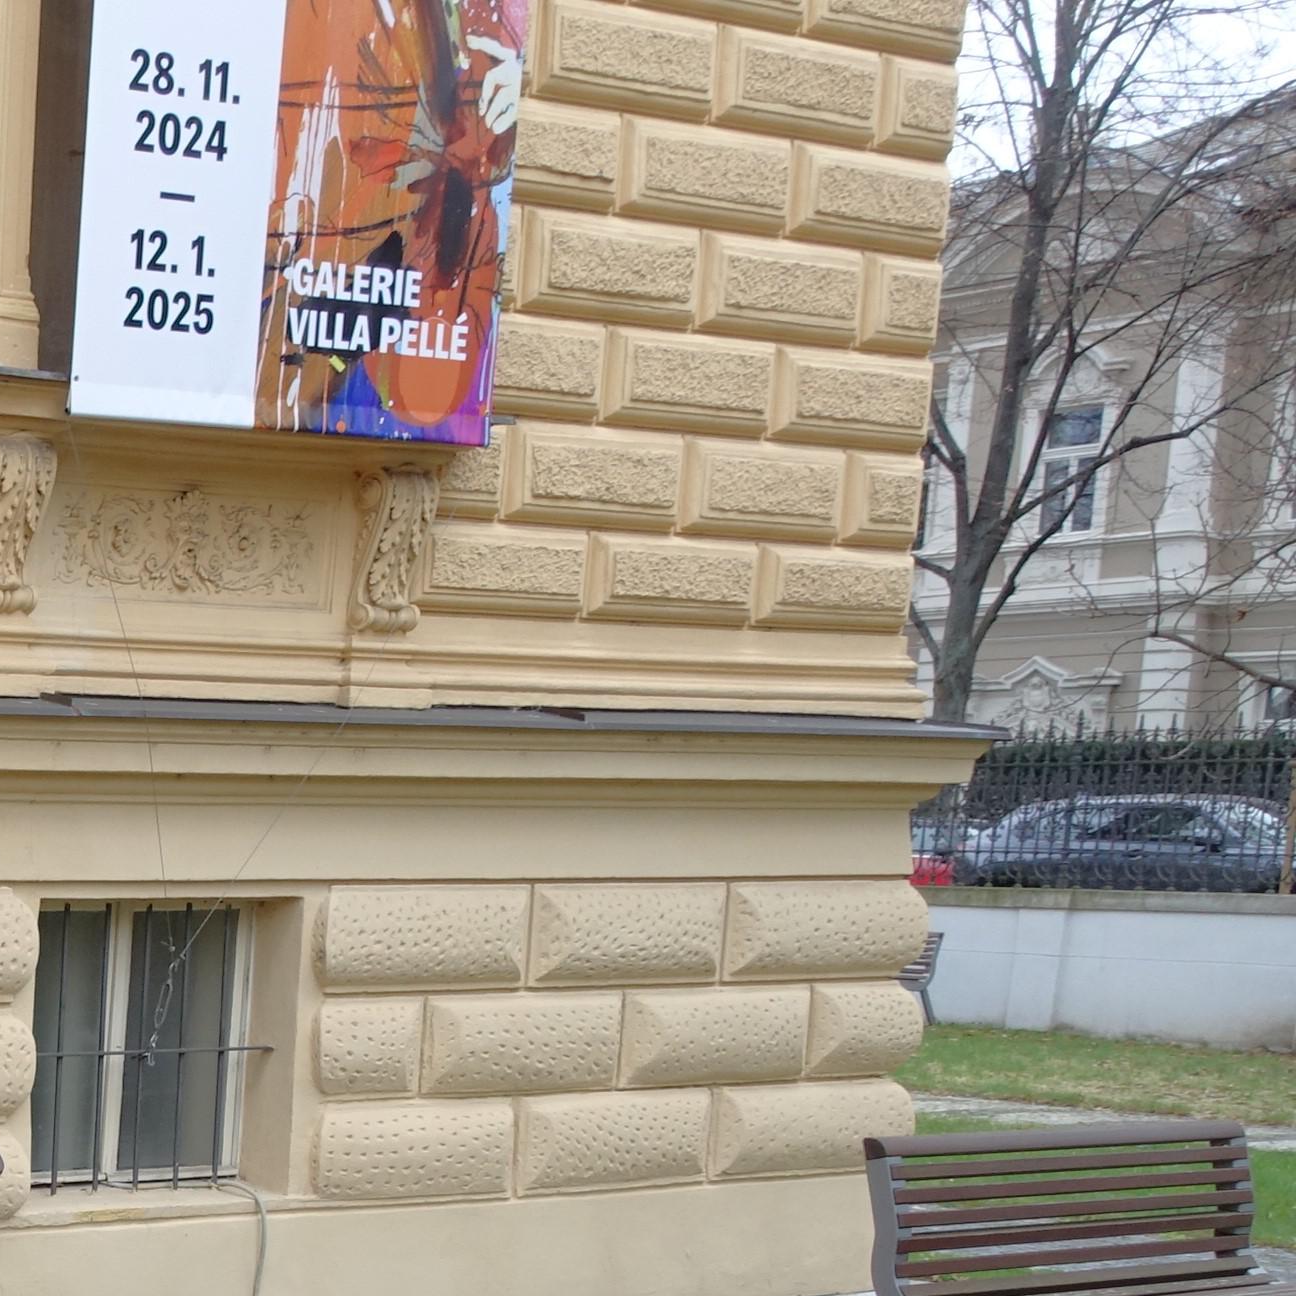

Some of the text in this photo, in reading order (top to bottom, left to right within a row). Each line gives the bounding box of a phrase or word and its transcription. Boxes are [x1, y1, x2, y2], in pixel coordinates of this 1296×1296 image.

[128, 48, 241, 105] 28. 11.
[133, 110, 228, 161] 2024
[129, 229, 216, 278] 12. 1.
[292, 258, 423, 308] GALERIE
[123, 286, 215, 335] 2025
[288, 307, 470, 361] VILLA PELLÉ
